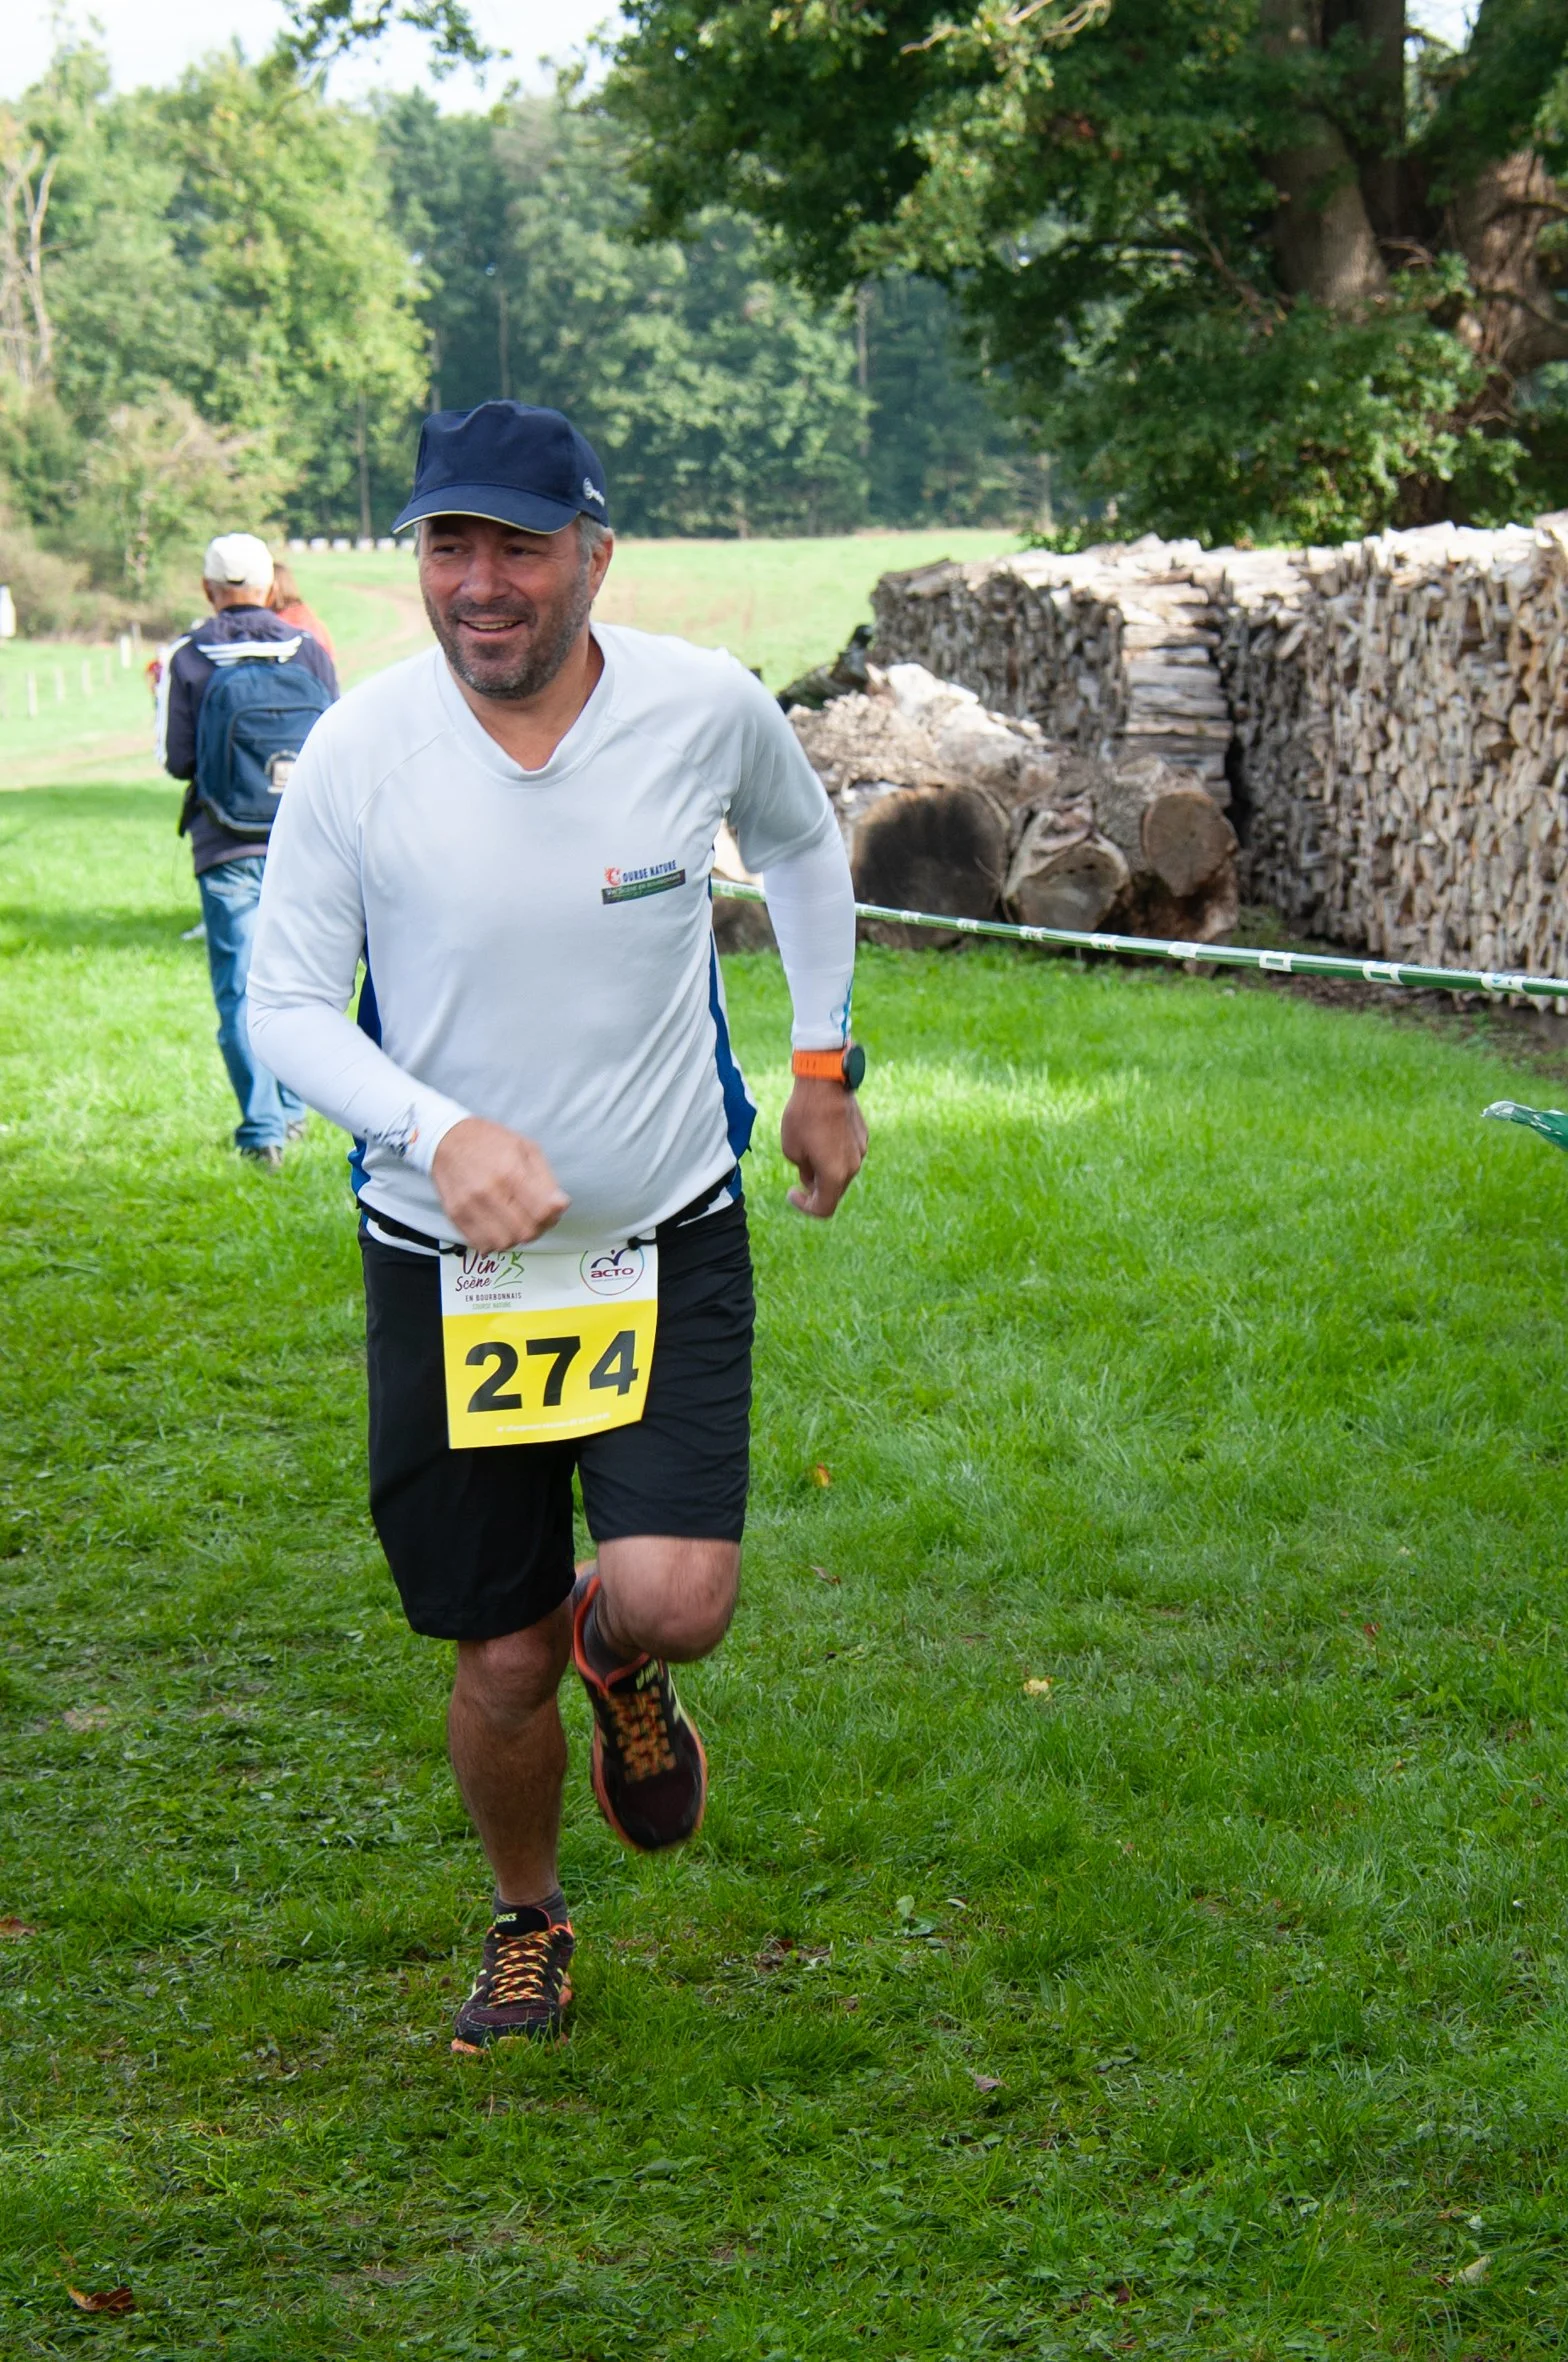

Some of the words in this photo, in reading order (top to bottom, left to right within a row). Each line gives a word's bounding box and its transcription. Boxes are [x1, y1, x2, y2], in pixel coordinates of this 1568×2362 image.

[455, 1275, 491, 1292] Scène
[475, 1292, 522, 1302] BOURBONNAIS
[465, 1329, 639, 1413] 274
